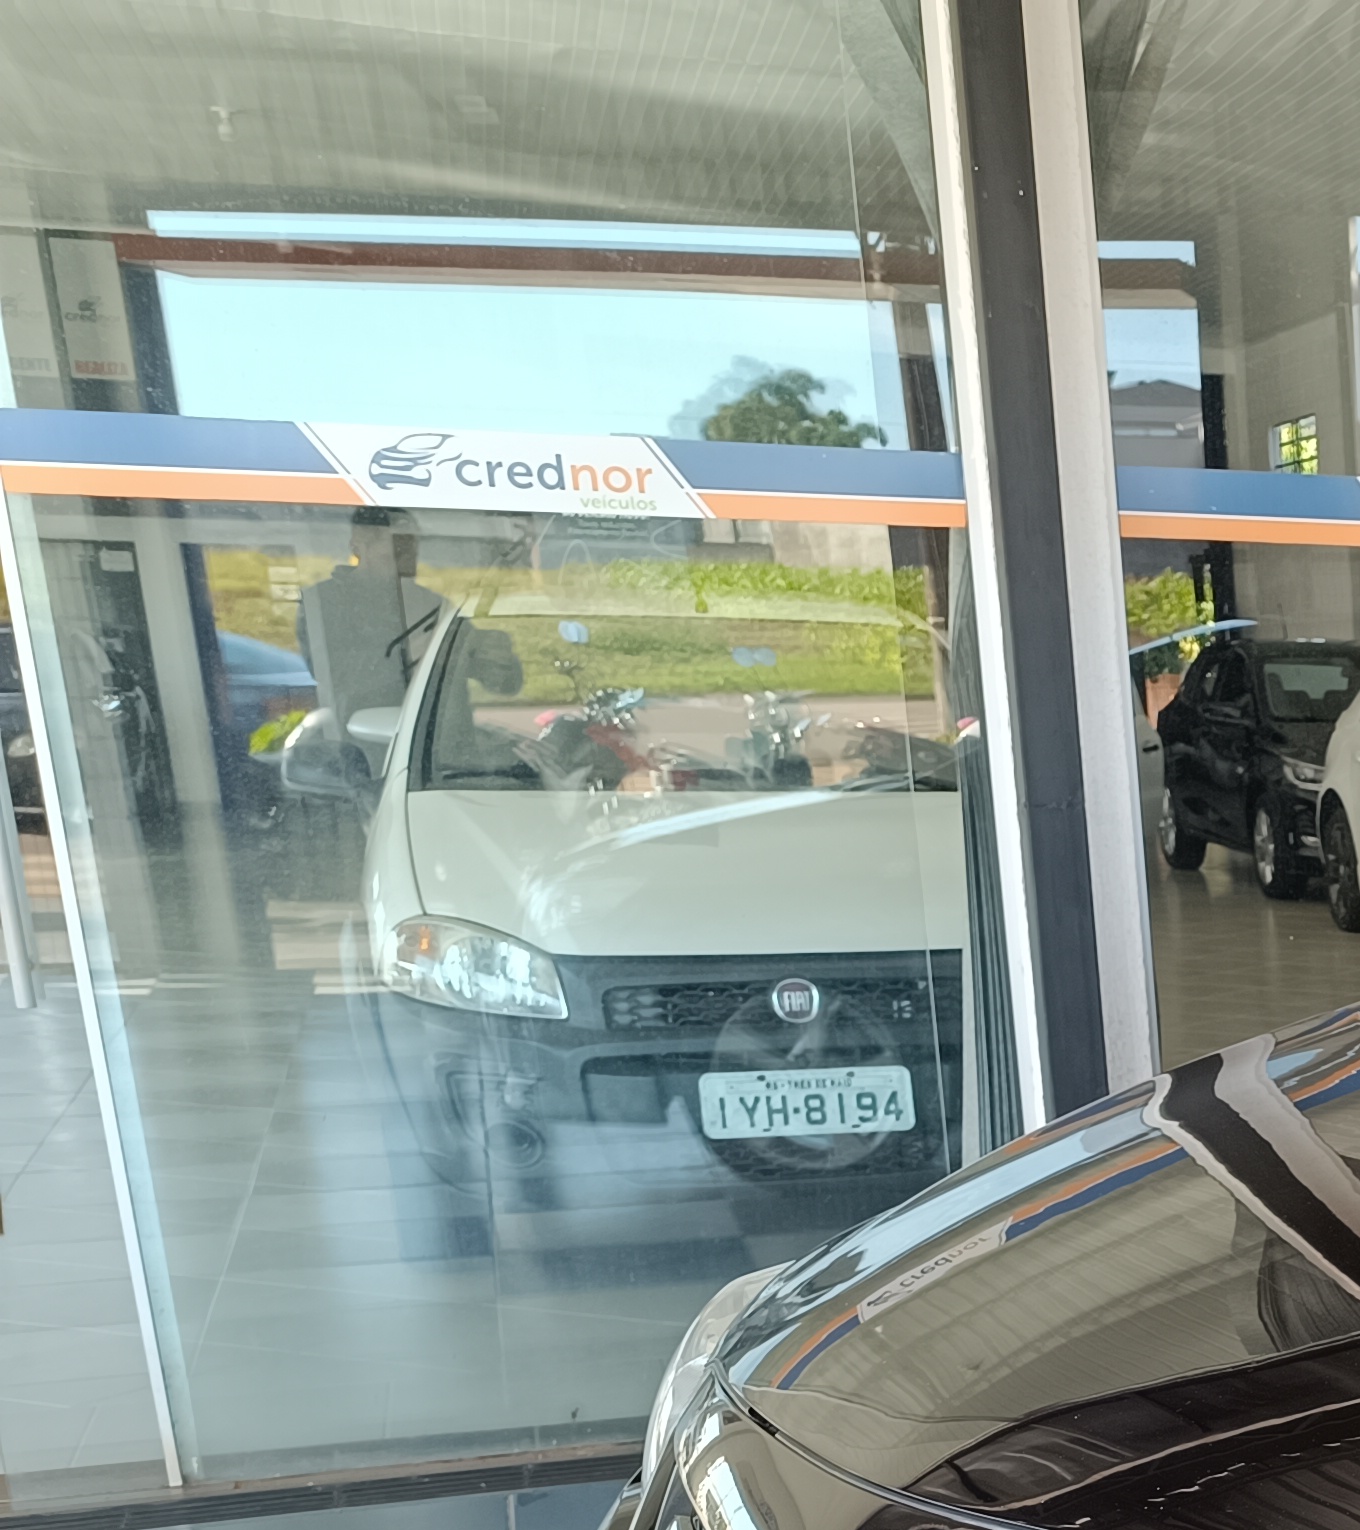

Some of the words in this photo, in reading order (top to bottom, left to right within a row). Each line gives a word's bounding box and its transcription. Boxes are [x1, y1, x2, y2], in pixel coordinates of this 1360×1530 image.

[455, 453, 653, 494] crednor
[579, 496, 657, 512] veículos
[782, 990, 810, 1012] FIAT
